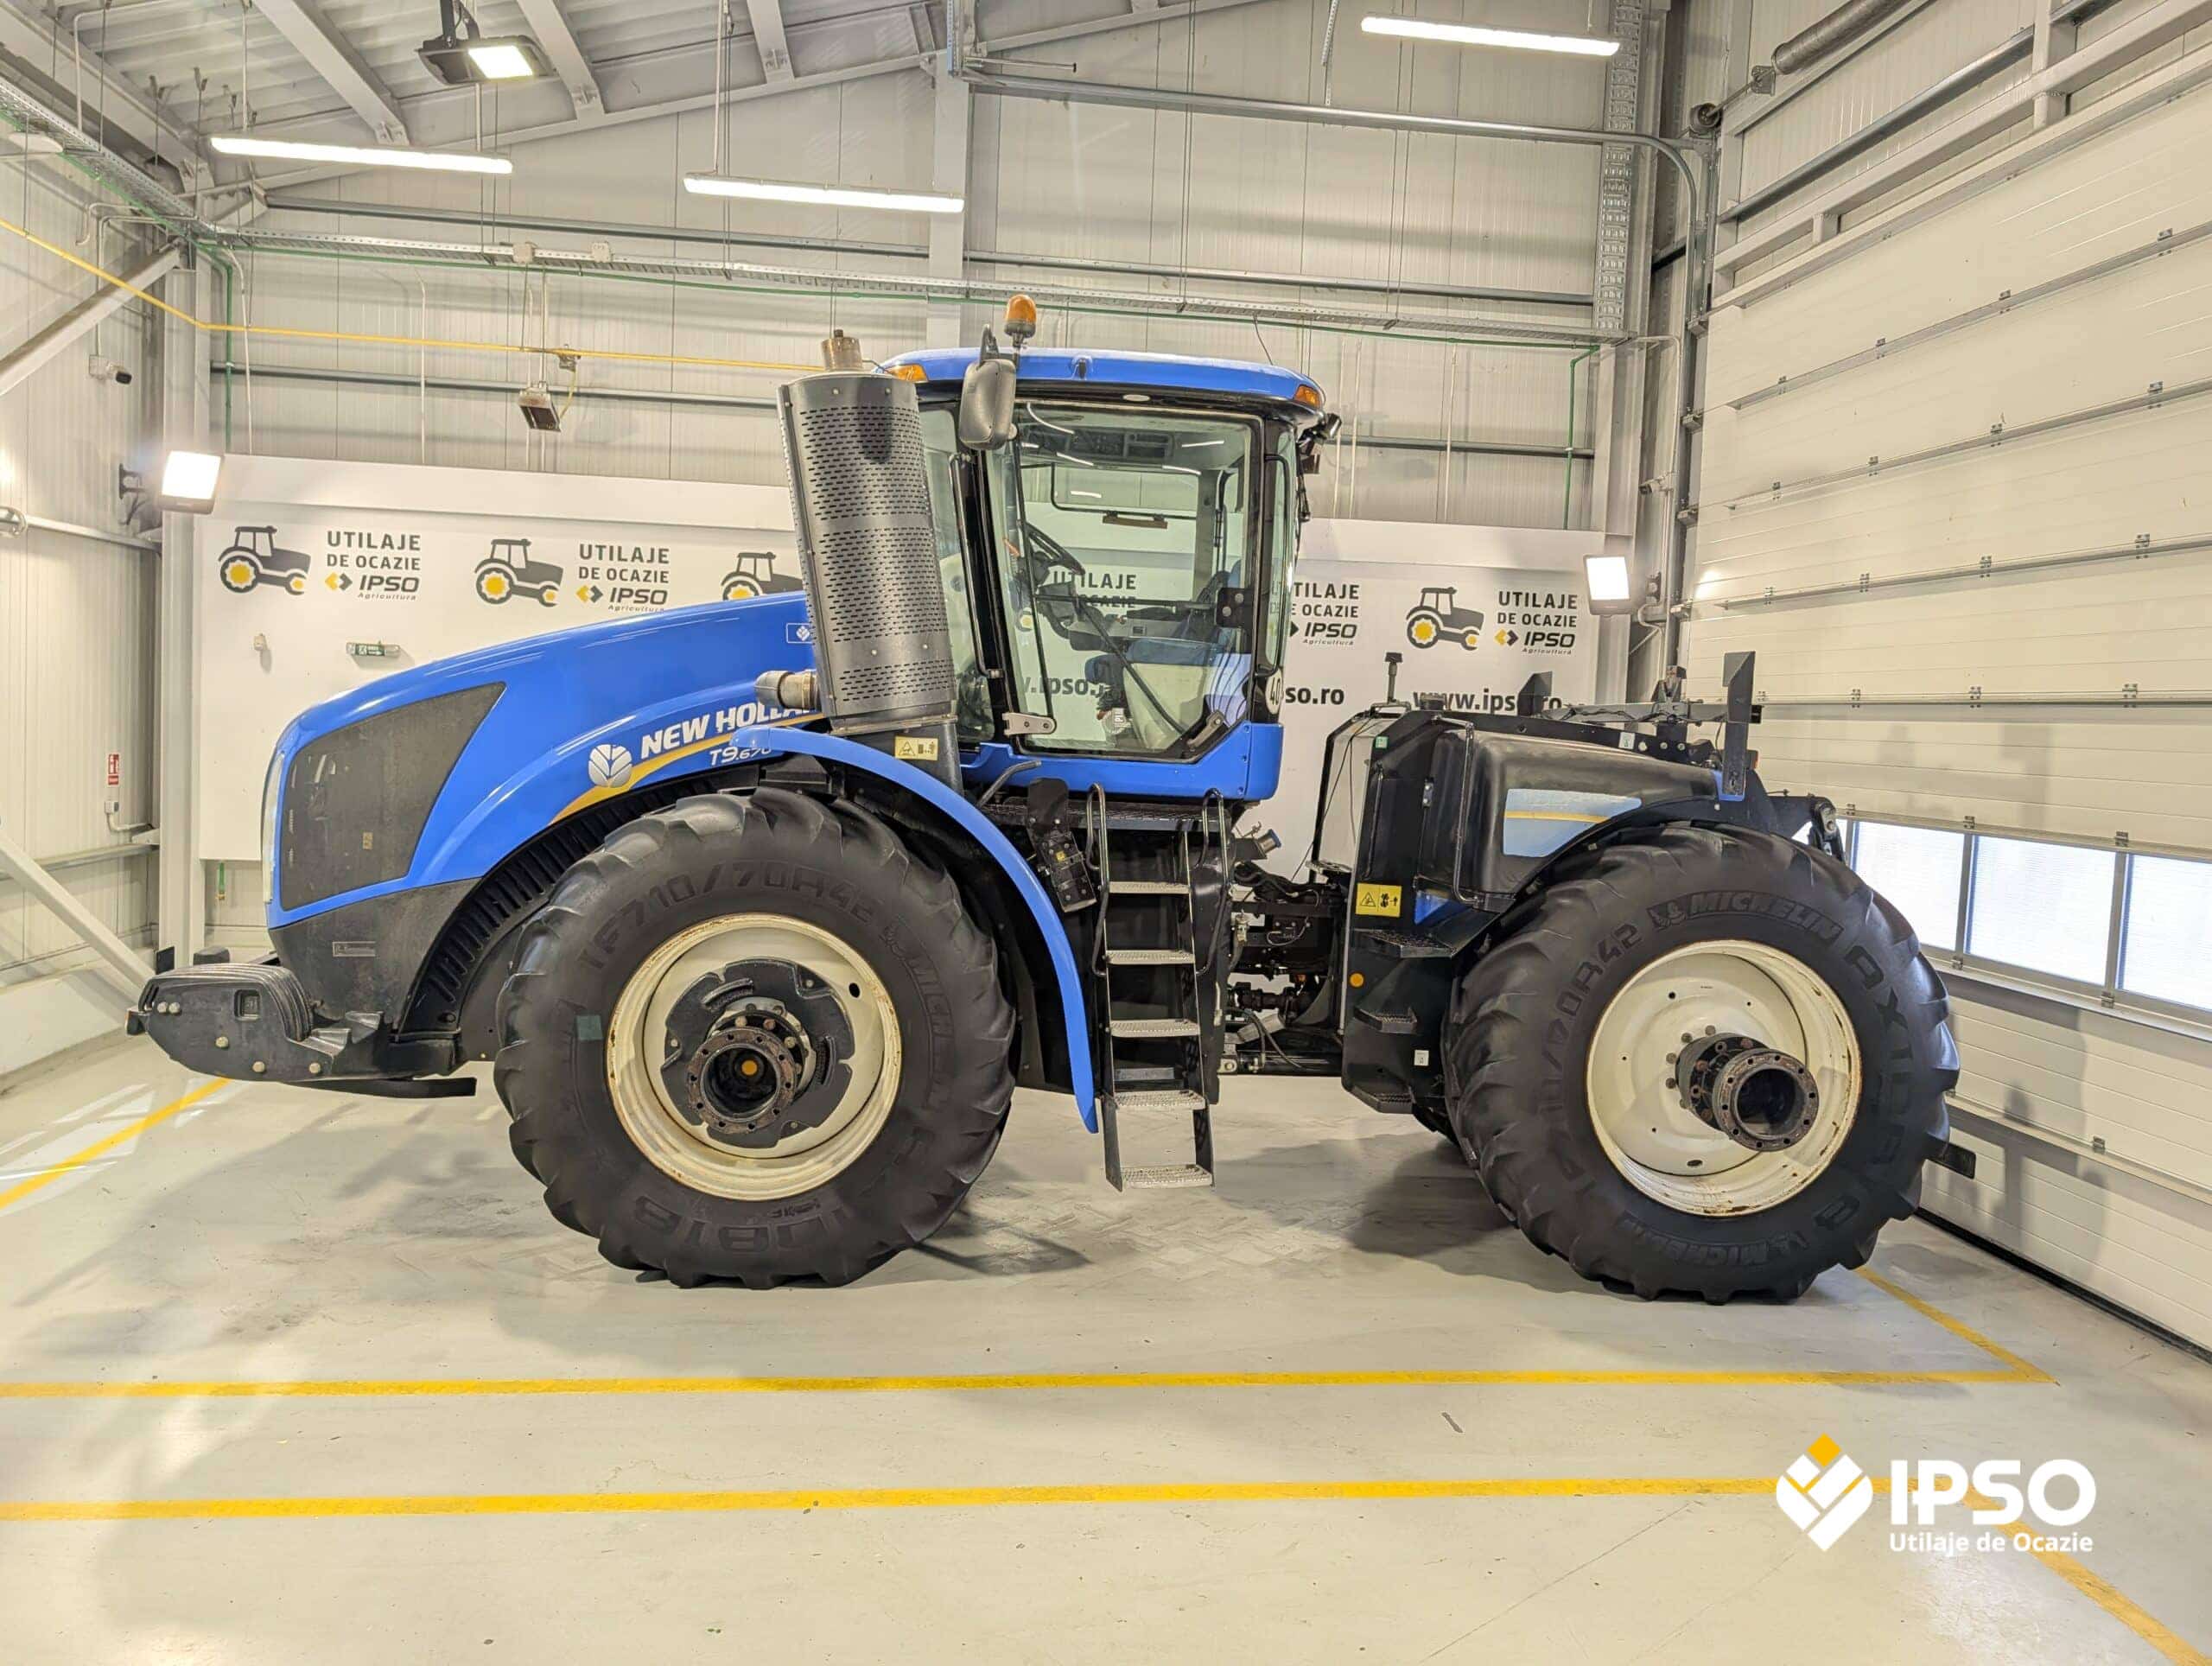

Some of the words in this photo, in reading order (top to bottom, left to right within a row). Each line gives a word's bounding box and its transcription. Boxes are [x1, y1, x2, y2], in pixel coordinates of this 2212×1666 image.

[327, 530, 421, 551] UTILAJE
[327, 553, 349, 568] DE
[355, 555, 421, 571] OCAZIE
[579, 544, 670, 564] UTILAJE
[578, 566, 601, 580] DE
[606, 568, 669, 583] OCAZIE
[359, 575, 419, 593] IPSO
[609, 587, 668, 605] IPSO
[1498, 591, 1578, 609] UTILAJE
[1301, 604, 1358, 618] OCAZIE
[1497, 612, 1516, 625] DE
[1522, 614, 1577, 627] OCAZIE
[1304, 622, 1357, 639] IPSO
[1523, 632, 1576, 647] IPSO
[1269, 677, 1281, 705] 40
[1286, 687, 1344, 705] so.ro
[641, 714, 710, 760] NEW
[1688, 891, 1843, 944] MICHELIN
